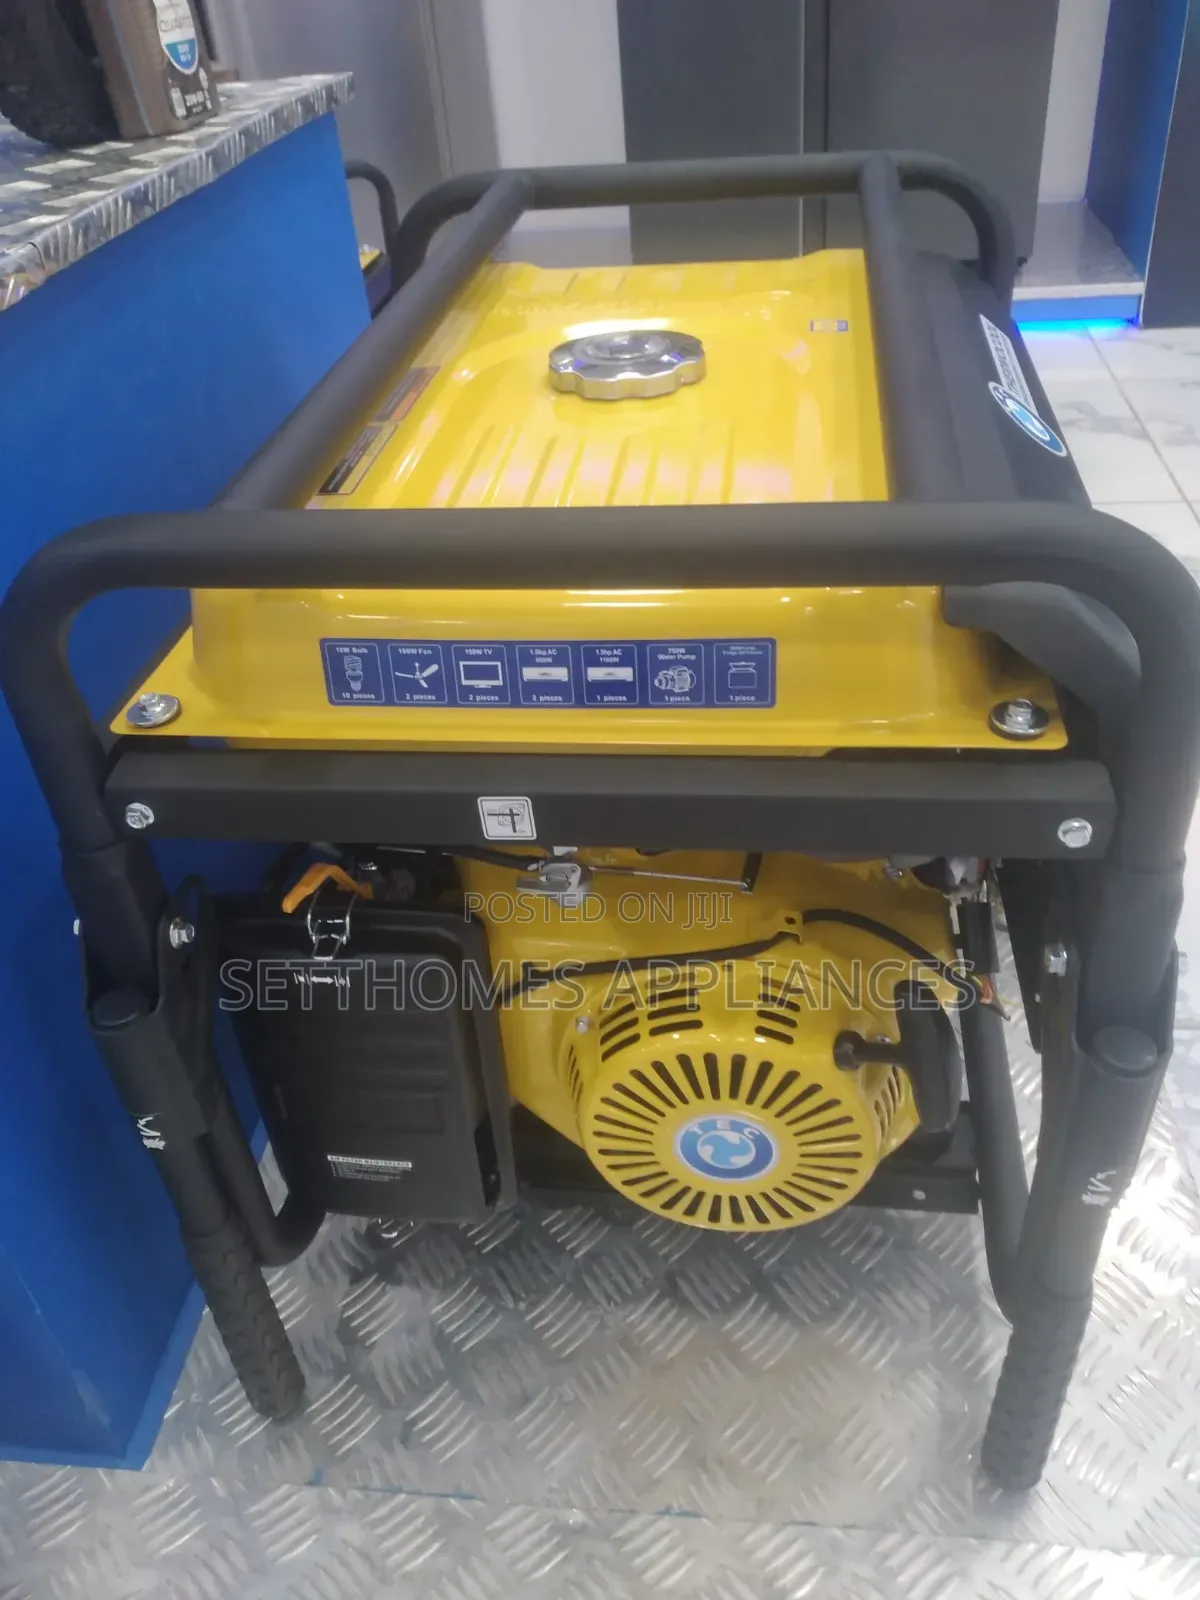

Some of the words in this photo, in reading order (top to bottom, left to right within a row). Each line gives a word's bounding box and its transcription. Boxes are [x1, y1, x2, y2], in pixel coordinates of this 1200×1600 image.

[353, 647, 368, 655] Bulb
[418, 648, 432, 656] Fan
[677, 653, 696, 661] Pump
[353, 693, 376, 701] pieces
[413, 694, 436, 702] pieces
[476, 694, 499, 702] pieces
[539, 695, 562, 703] pieces
[686, 1118, 761, 1141] TEC
